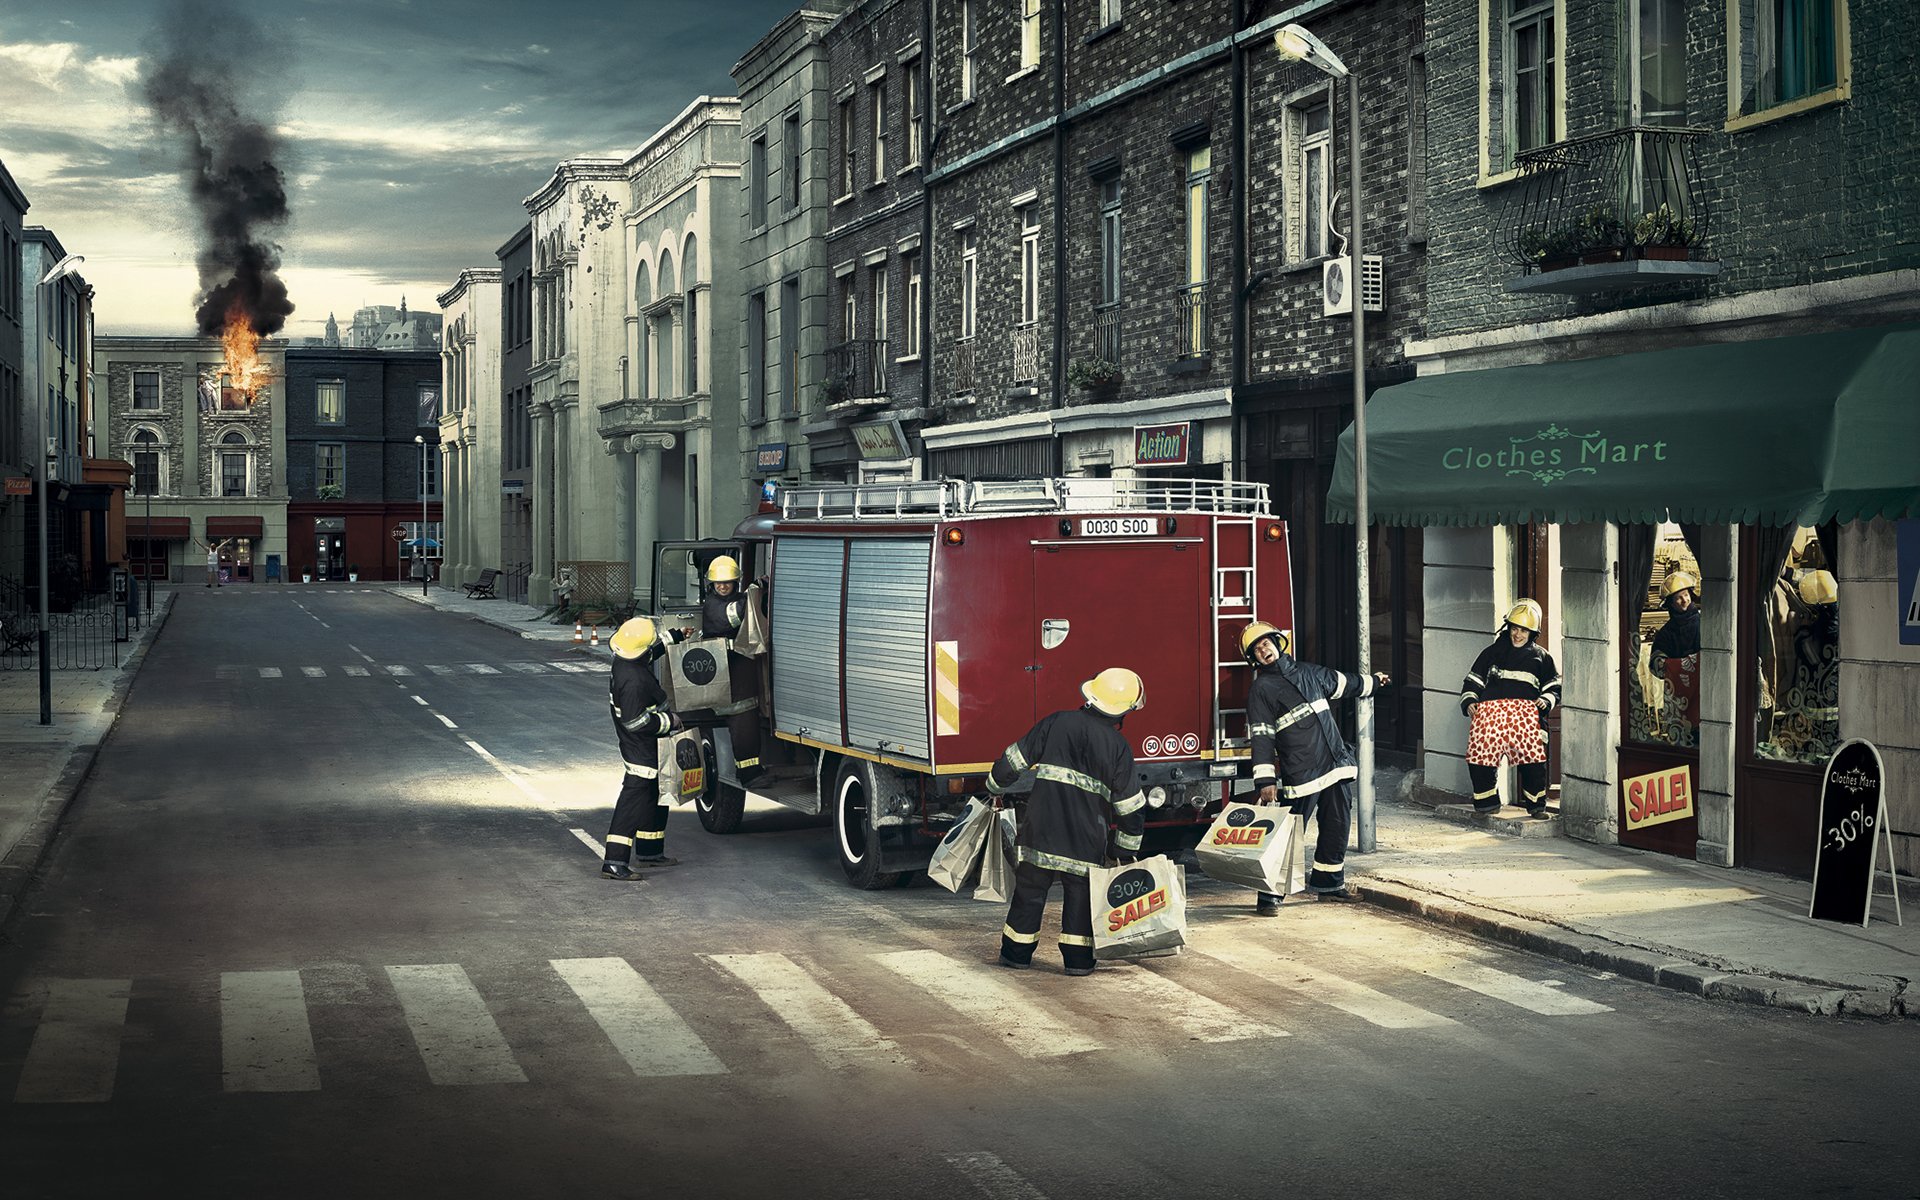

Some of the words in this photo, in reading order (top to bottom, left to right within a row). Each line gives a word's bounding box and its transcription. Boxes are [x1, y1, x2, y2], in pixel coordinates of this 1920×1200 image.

[758, 450, 783, 466] SHOP
[1442, 443, 1562, 470] Clothes
[1579, 437, 1668, 464] Mart
[685, 658, 715, 673] -30%
[1147, 741, 1158, 751] 50
[1167, 740, 1177, 749] 70
[1185, 739, 1196, 748] 90
[1830, 771, 1858, 786] Clothes
[1858, 774, 1876, 788] Mart
[1629, 772, 1688, 823] SALE!
[1823, 803, 1875, 852] -30%
[1213, 827, 1265, 846] SALE!
[1108, 888, 1167, 932] SALE!
